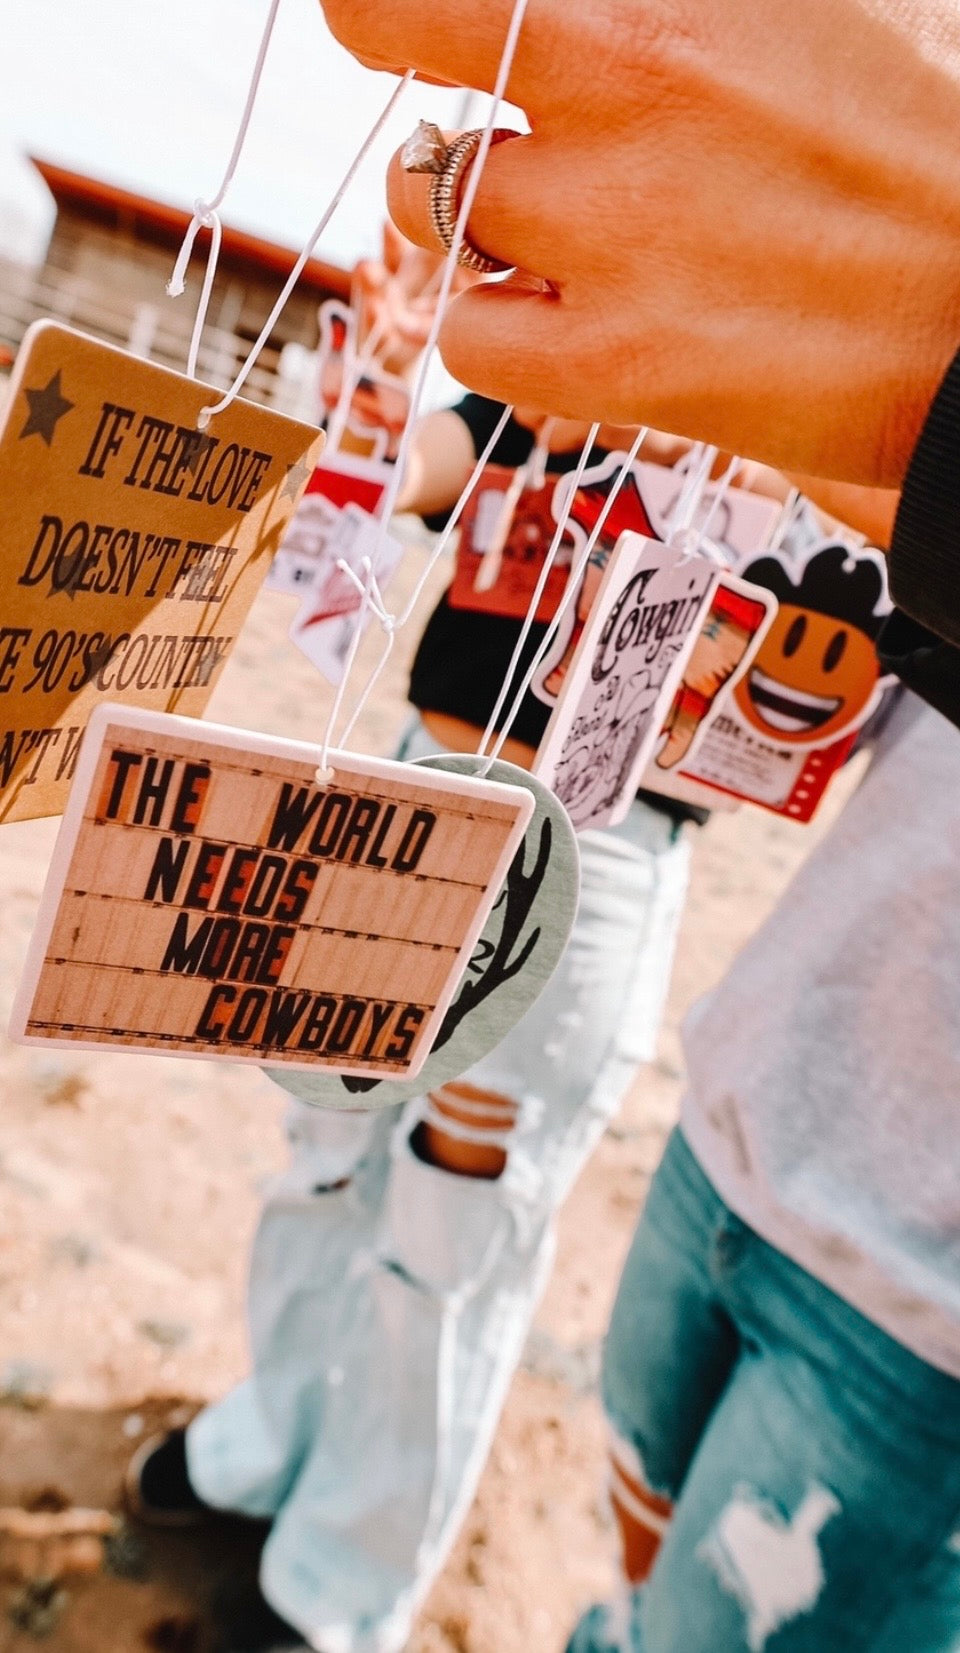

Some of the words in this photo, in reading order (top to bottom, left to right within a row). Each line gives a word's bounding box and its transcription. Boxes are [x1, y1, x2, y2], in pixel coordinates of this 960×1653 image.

[78, 402, 135, 479] IF
[123, 416, 202, 497] THE
[187, 437, 273, 513] LOVE
[17, 514, 181, 599] DOESN'T
[164, 541, 238, 604] FEEL
[22, 629, 111, 693] 90'S
[96, 635, 233, 693] COUNTRY
[591, 567, 715, 687] Cowgirl
[0, 728, 63, 790] N'T
[105, 750, 210, 833] THE
[266, 782, 437, 872] WORLD
[143, 837, 320, 922] NEEDS
[160, 913, 297, 985] MORE
[194, 985, 426, 1059] COWBOYS
